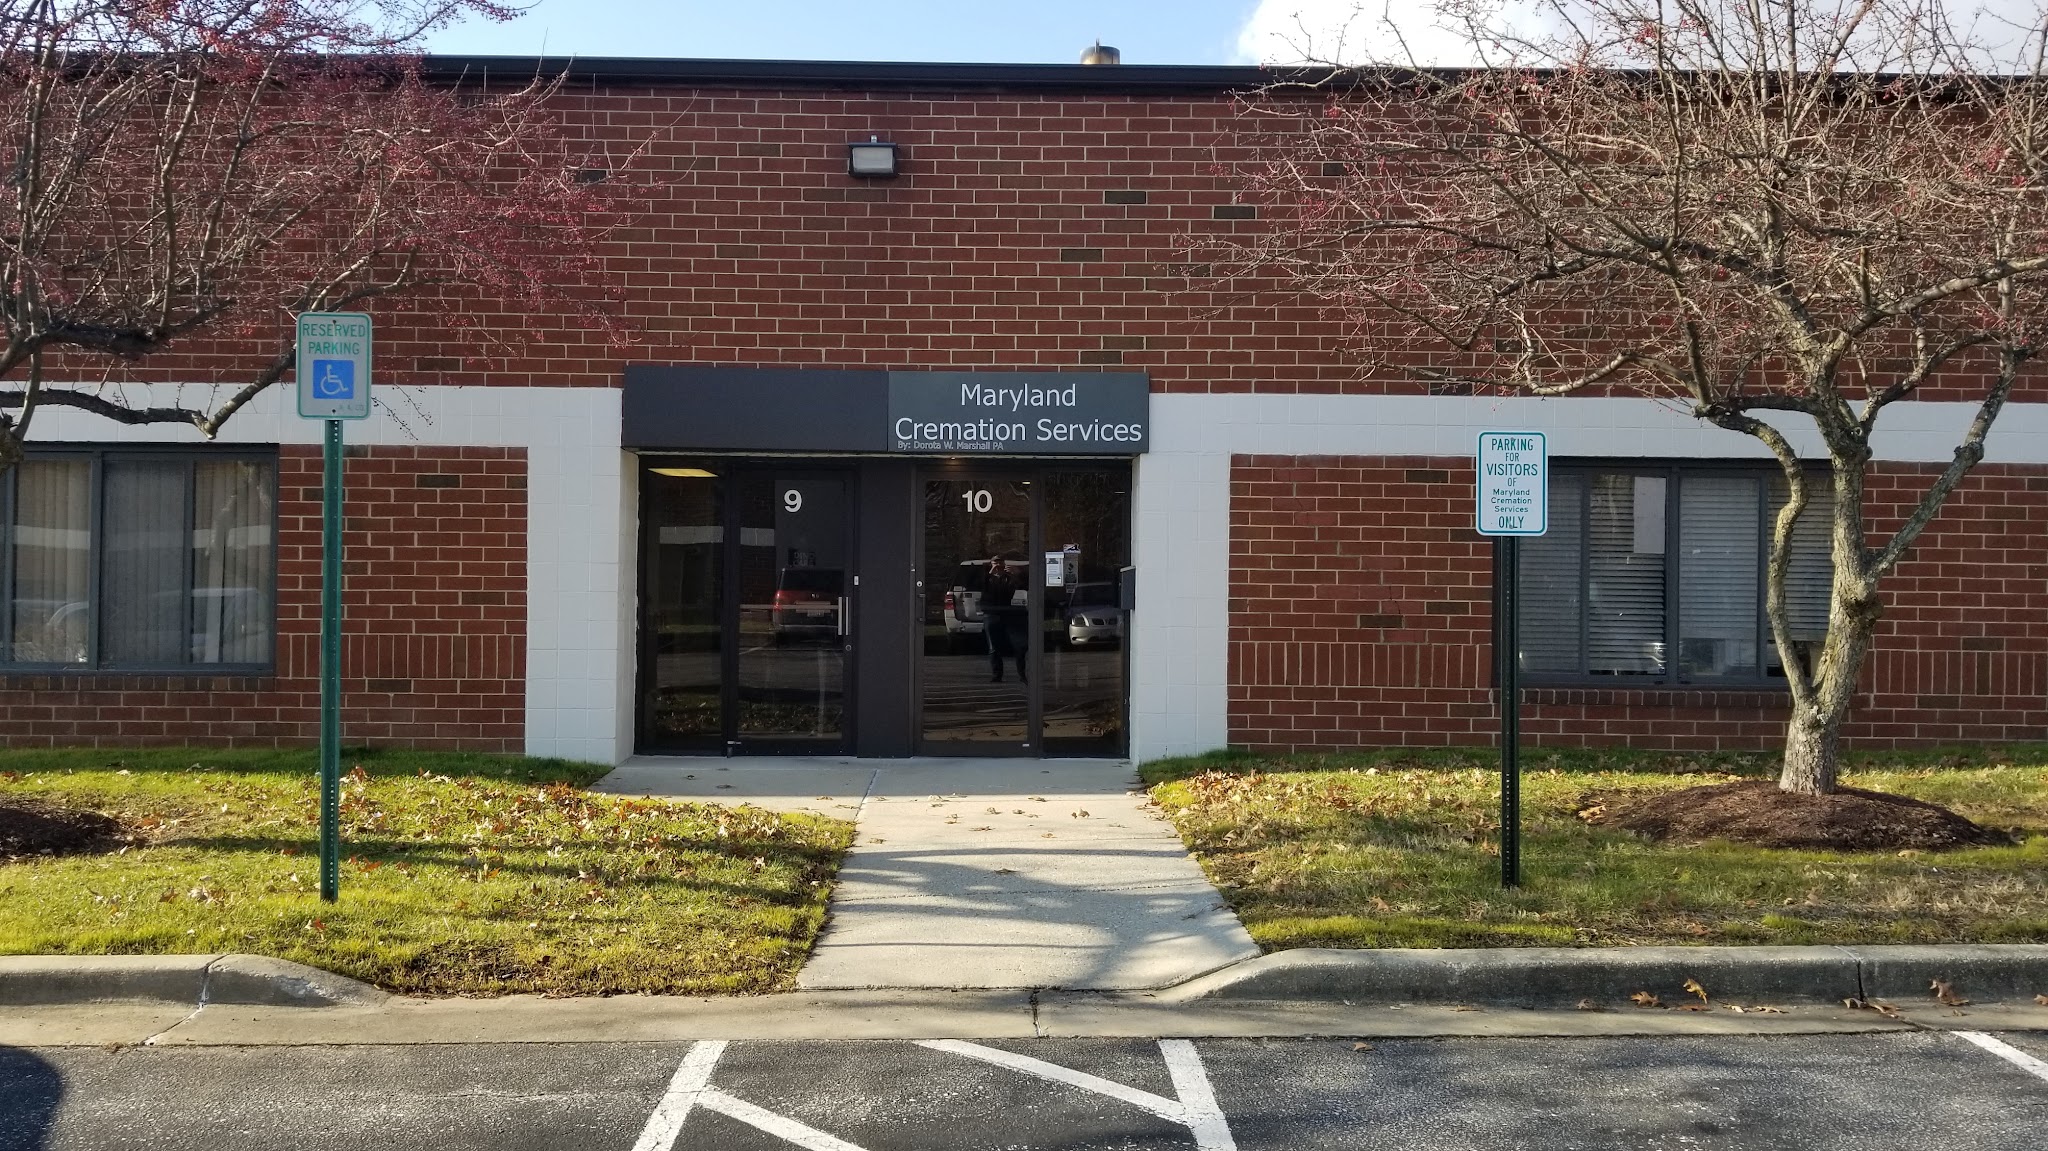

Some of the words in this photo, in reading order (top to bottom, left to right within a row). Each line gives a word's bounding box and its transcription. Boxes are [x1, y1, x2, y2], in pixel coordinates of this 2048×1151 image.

[302, 323, 366, 337] RESERVED
[308, 341, 360, 355] PARKING
[961, 383, 1076, 411] Maryland
[895, 417, 1026, 441] Cremation
[1036, 418, 1142, 442] Services
[897, 440, 911, 450] By:
[913, 441, 942, 450] Dorota
[943, 441, 954, 450] W.
[956, 441, 991, 450] Marshall
[993, 442, 1004, 450] PA
[1491, 438, 1534, 451] PARKING
[1505, 452, 1520, 462] FOR
[1486, 463, 1538, 476] VISITORS
[1507, 477, 1517, 487] OF
[1493, 488, 1530, 497] Maryland
[783, 489, 802, 513] 9
[961, 489, 993, 513] 10
[1490, 496, 1532, 504] Cremation
[1494, 505, 1529, 513] Services
[1498, 515, 1525, 529] ONLY
